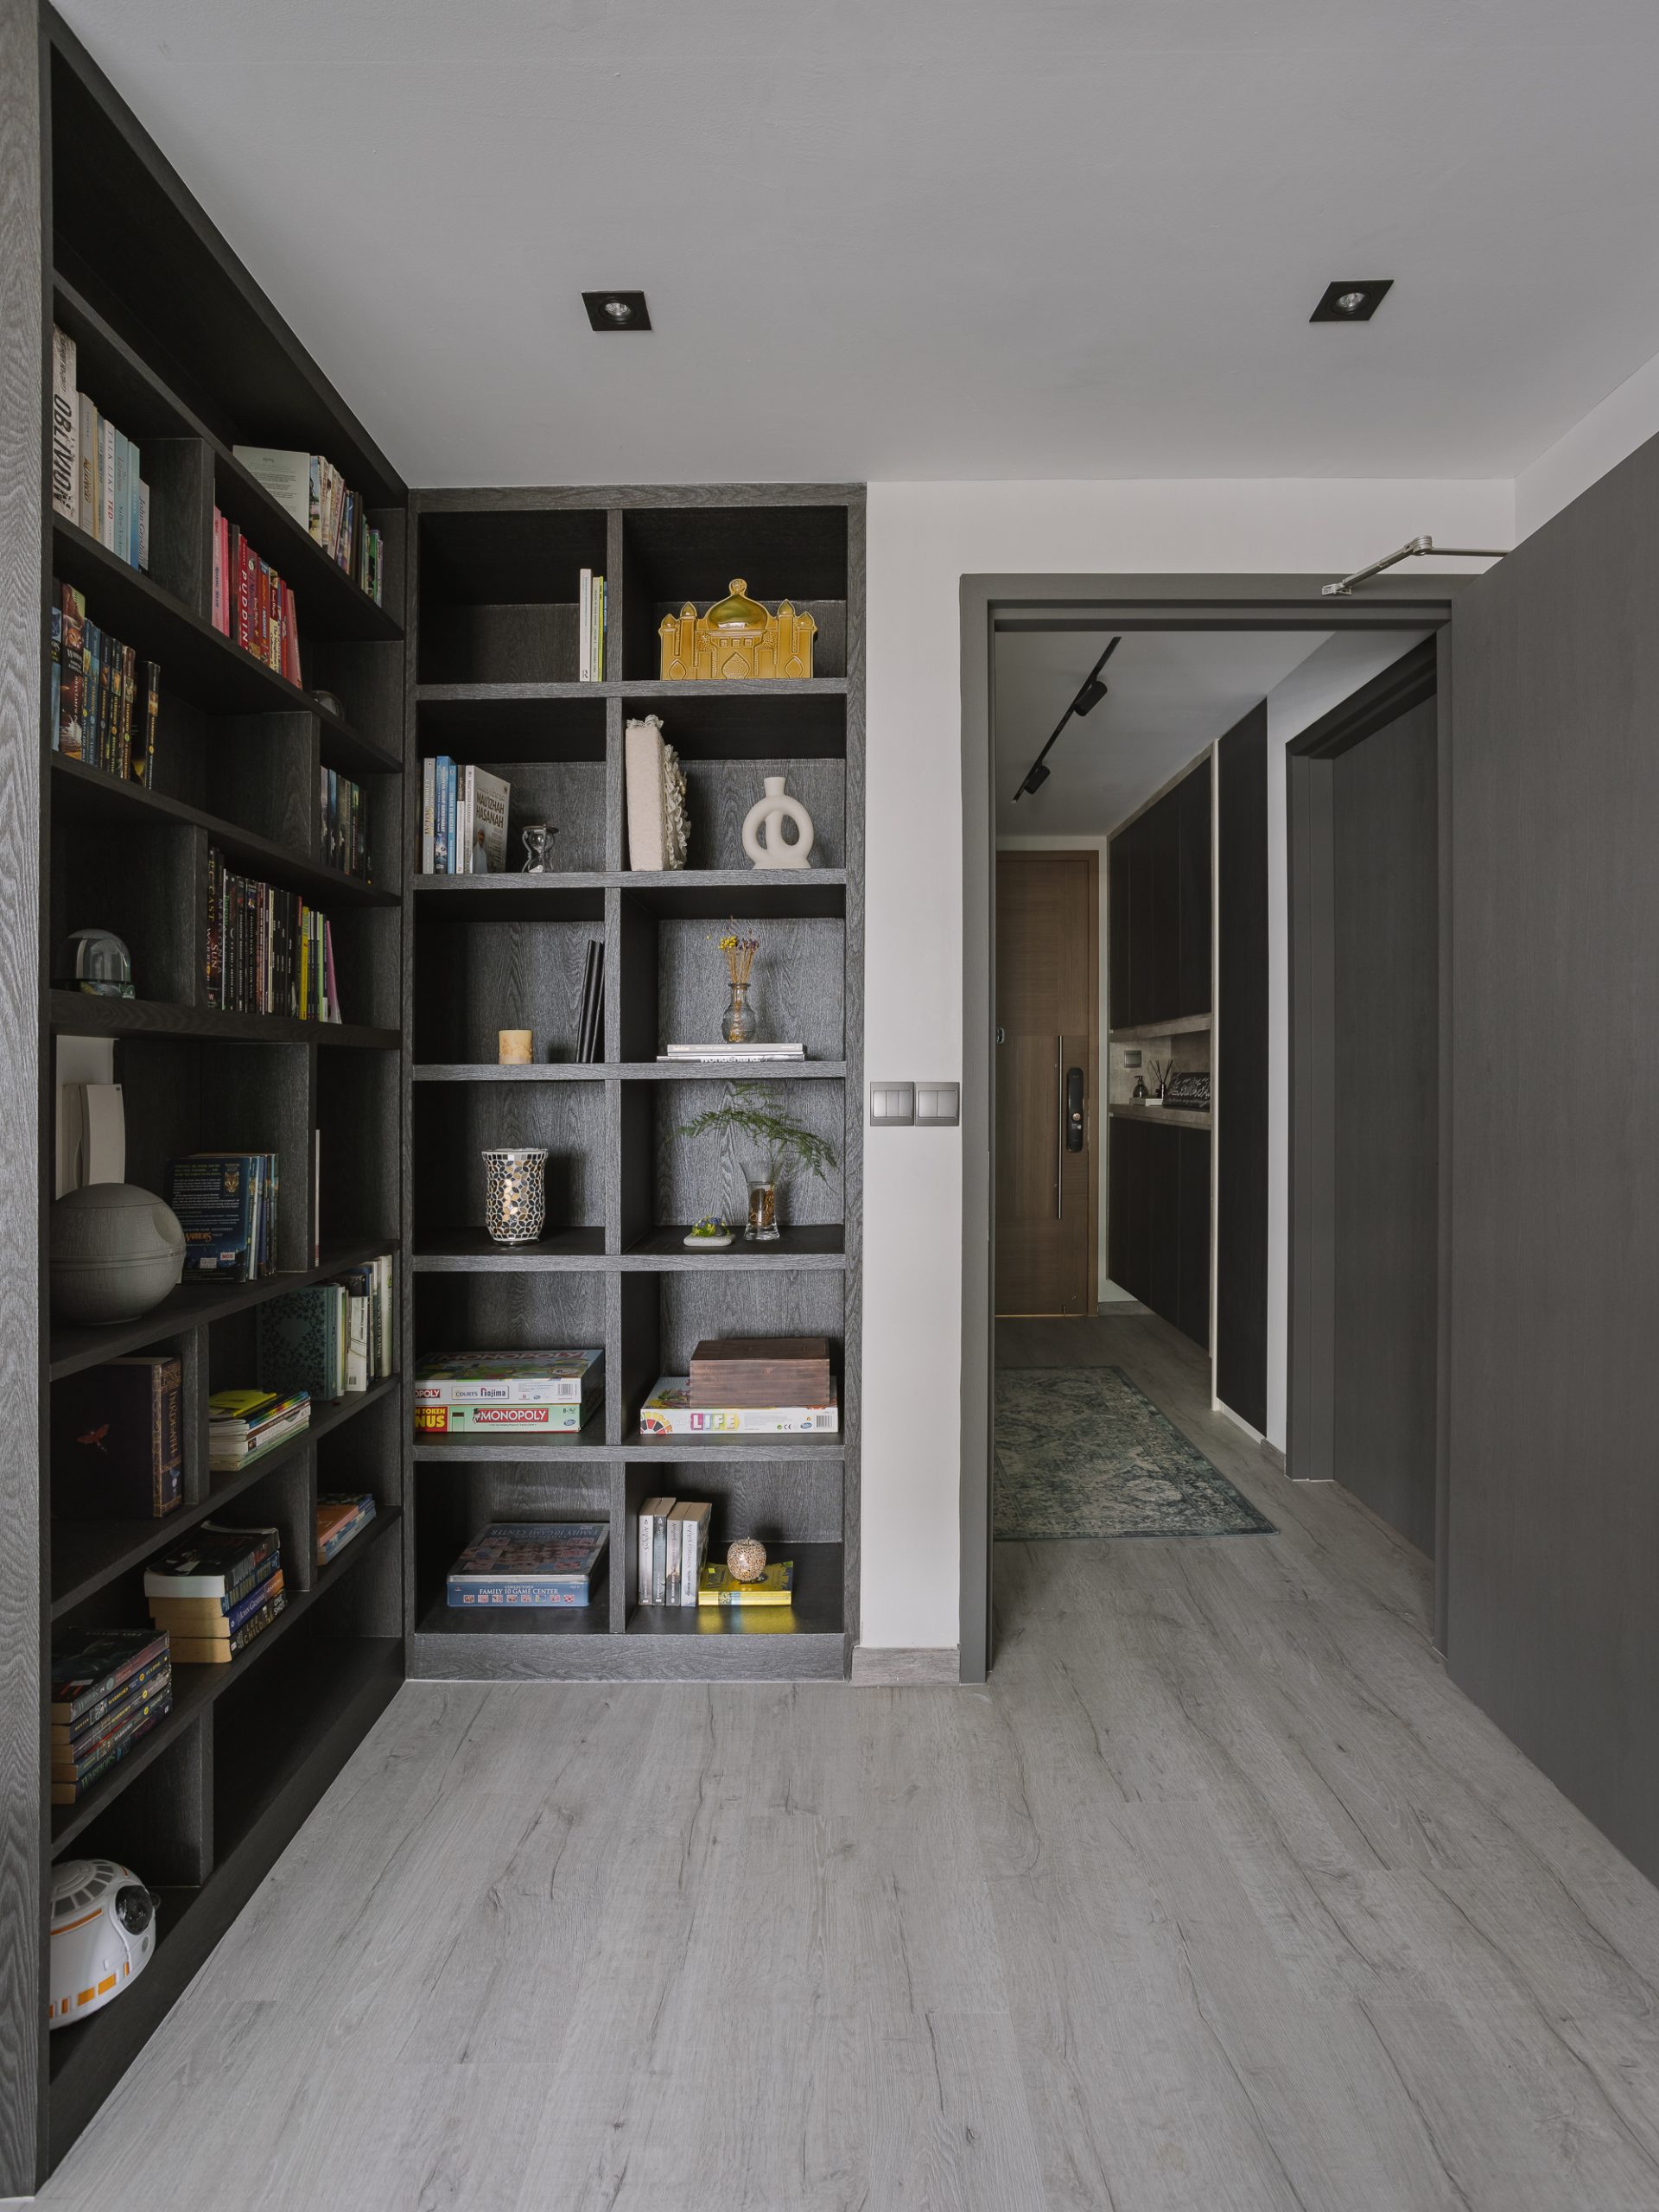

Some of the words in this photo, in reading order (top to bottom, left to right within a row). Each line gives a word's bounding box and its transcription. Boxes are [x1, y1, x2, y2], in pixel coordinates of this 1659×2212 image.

[53, 394, 73, 512] OBLIVION
[476, 804, 504, 829] HASANAH
[211, 944, 219, 969] SUN
[442, 1351, 582, 1361] MONOPOLY
[482, 1409, 547, 1421] MONOPOLY
[692, 1414, 737, 1431] LIFE
[273, 1593, 283, 1608] ONE
[273, 1601, 287, 1618] SHOT
[246, 1614, 261, 1632] LEE
[244, 1621, 264, 1645] CHILD
